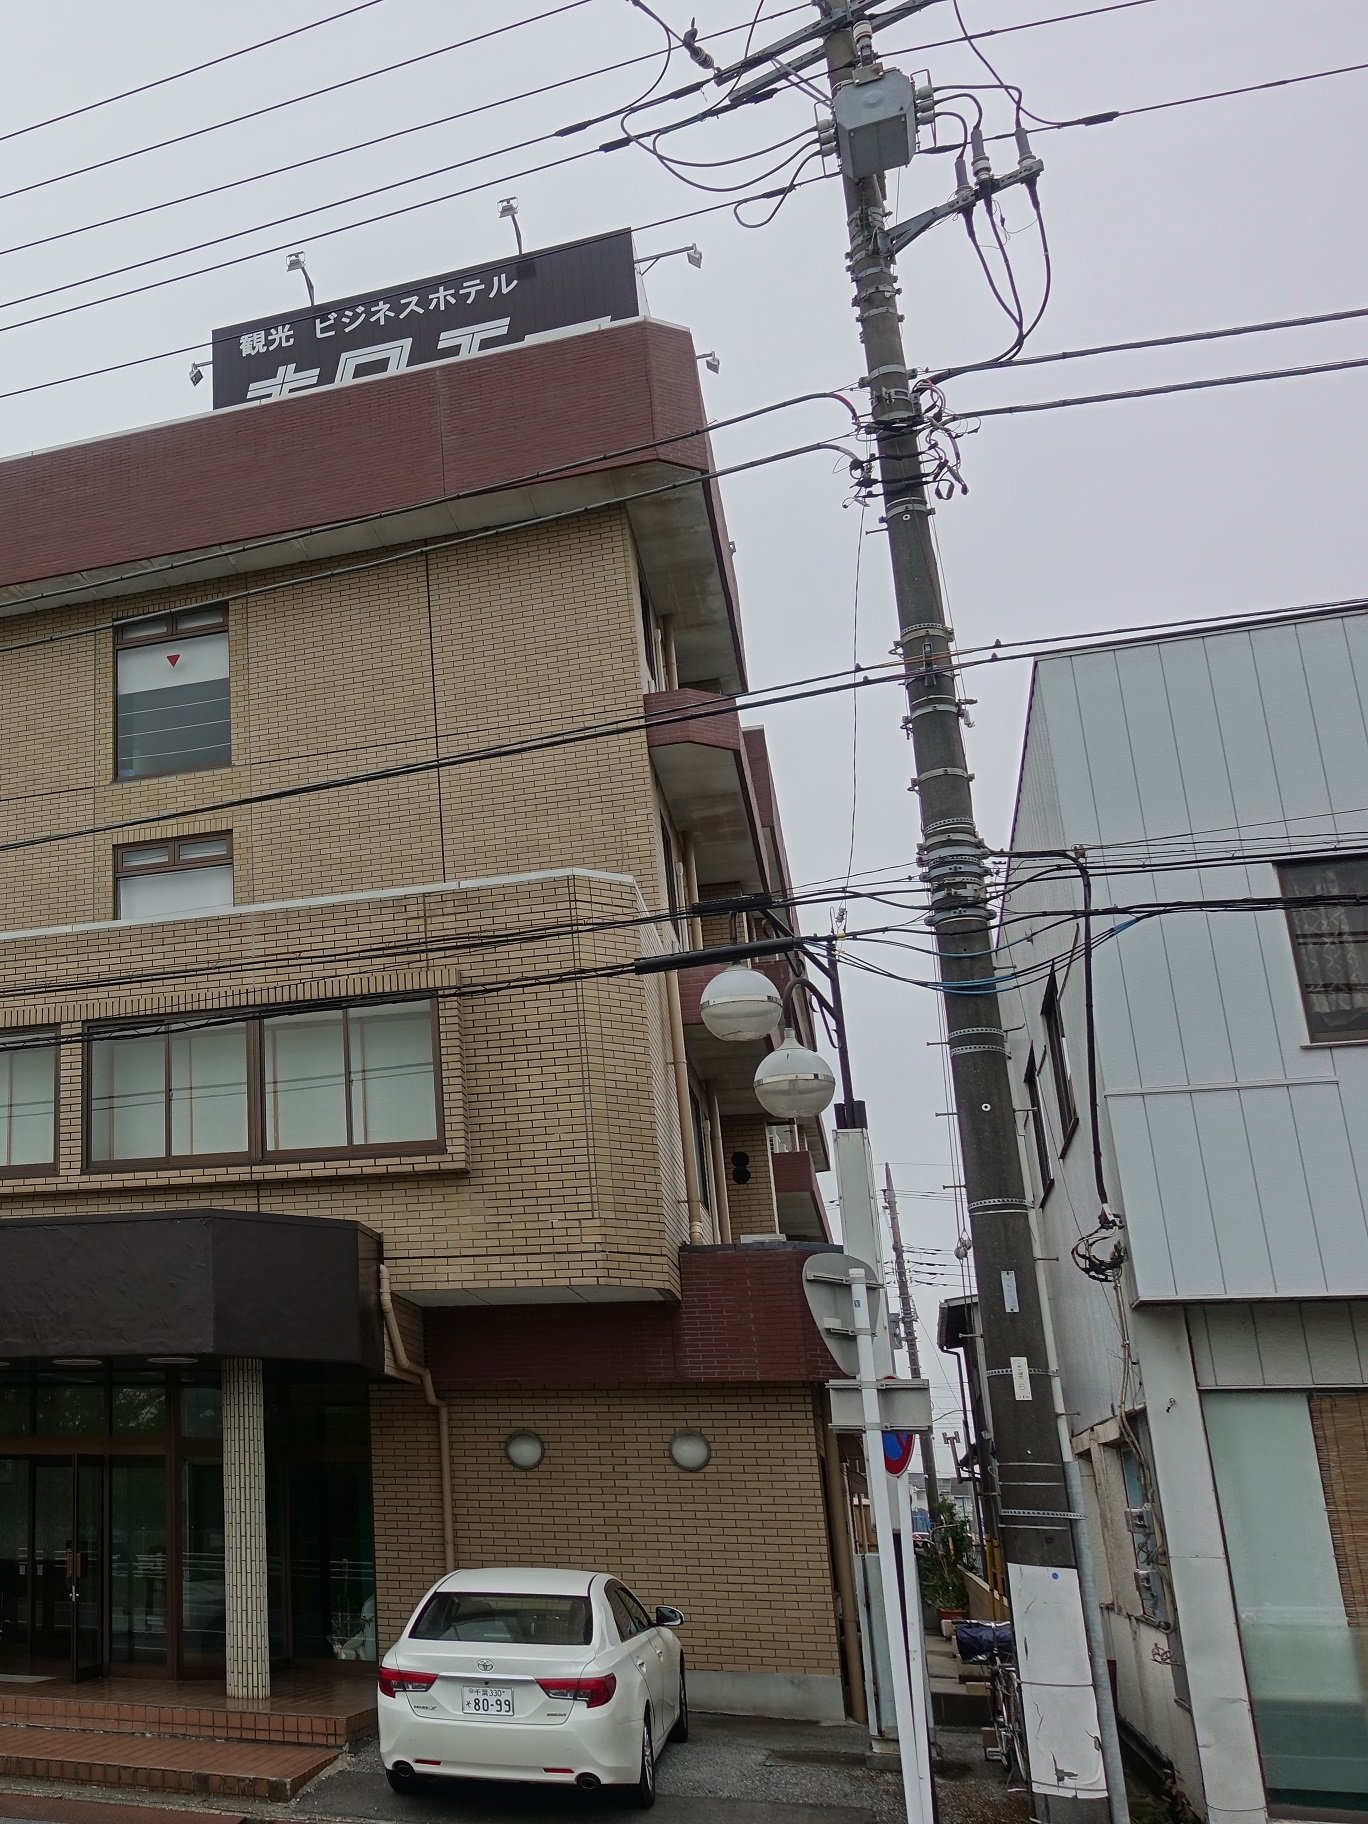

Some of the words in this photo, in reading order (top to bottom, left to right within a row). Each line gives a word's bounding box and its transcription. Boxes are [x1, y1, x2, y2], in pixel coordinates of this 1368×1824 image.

[239, 325, 295, 358] 観光
[314, 273, 519, 339] ビジネスホテル
[474, 1698, 511, 1712] 80-99
